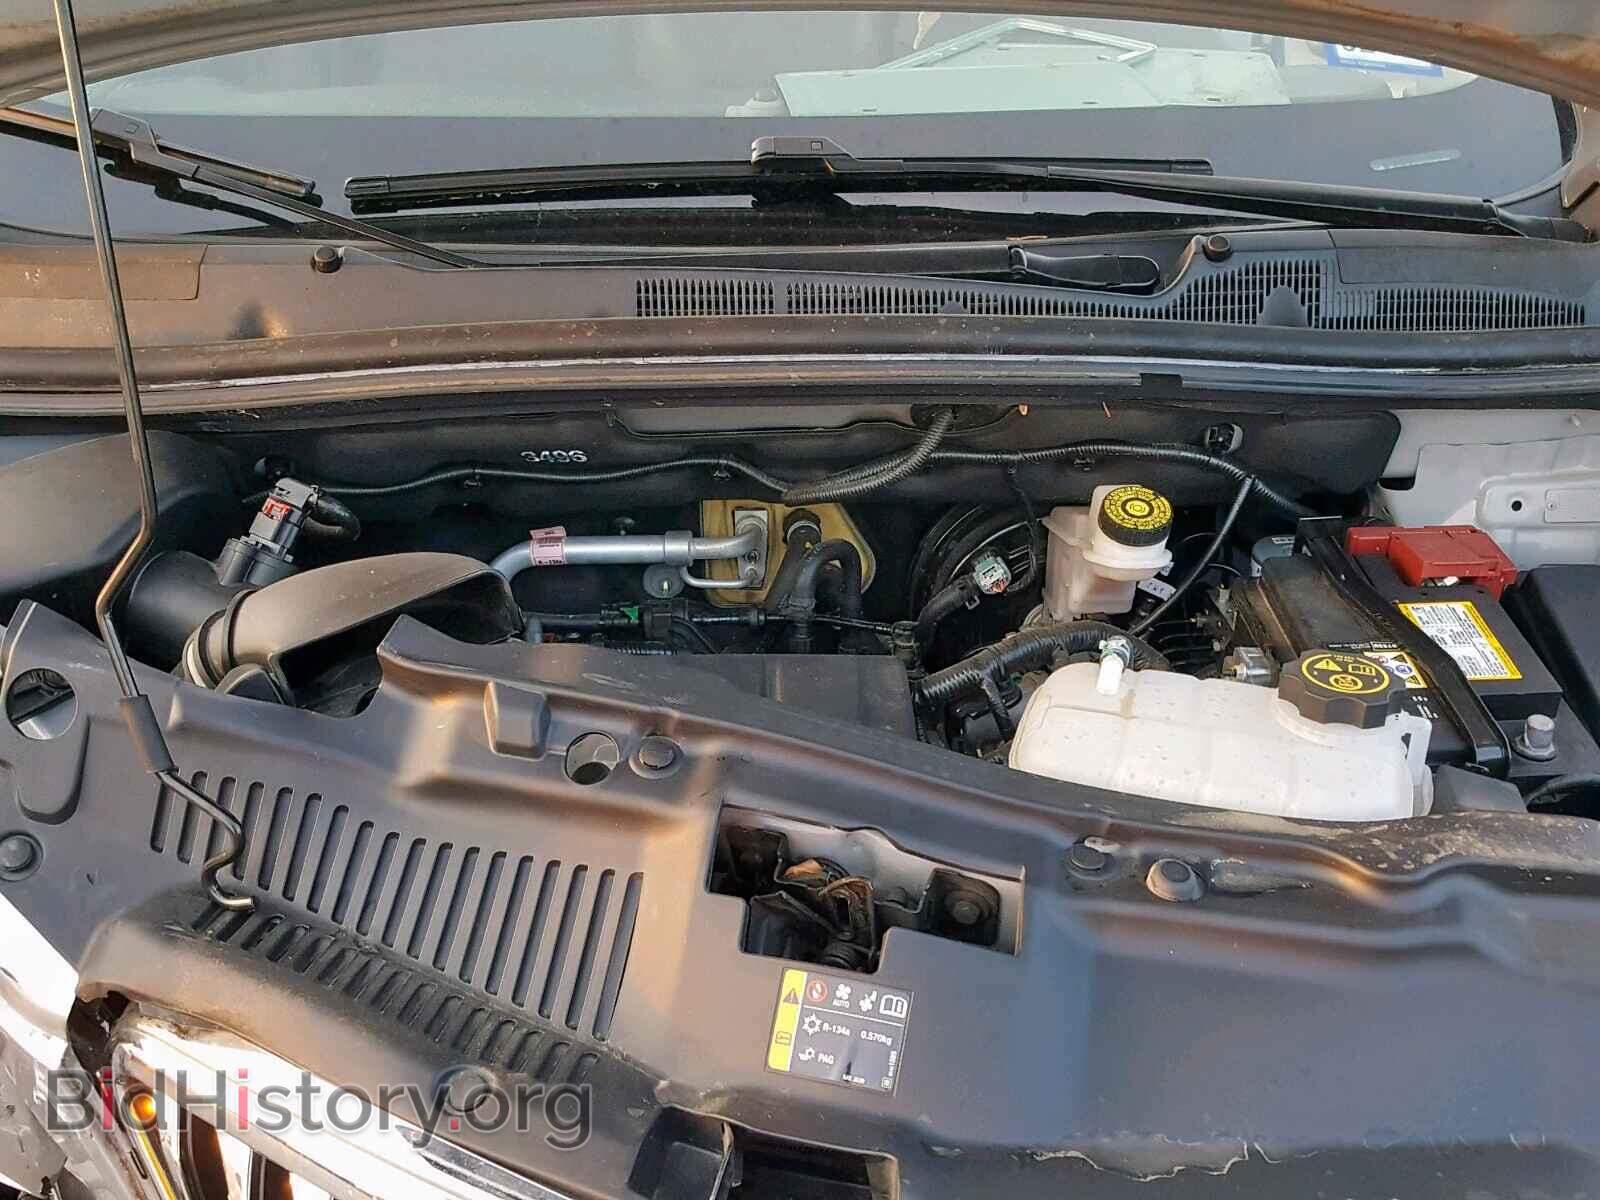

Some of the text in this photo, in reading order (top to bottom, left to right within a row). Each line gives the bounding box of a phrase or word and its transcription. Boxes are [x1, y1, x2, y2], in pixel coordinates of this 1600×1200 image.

[822, 1023, 892, 1045] R-134a 0.570kg
[818, 1052, 835, 1065] PAG
